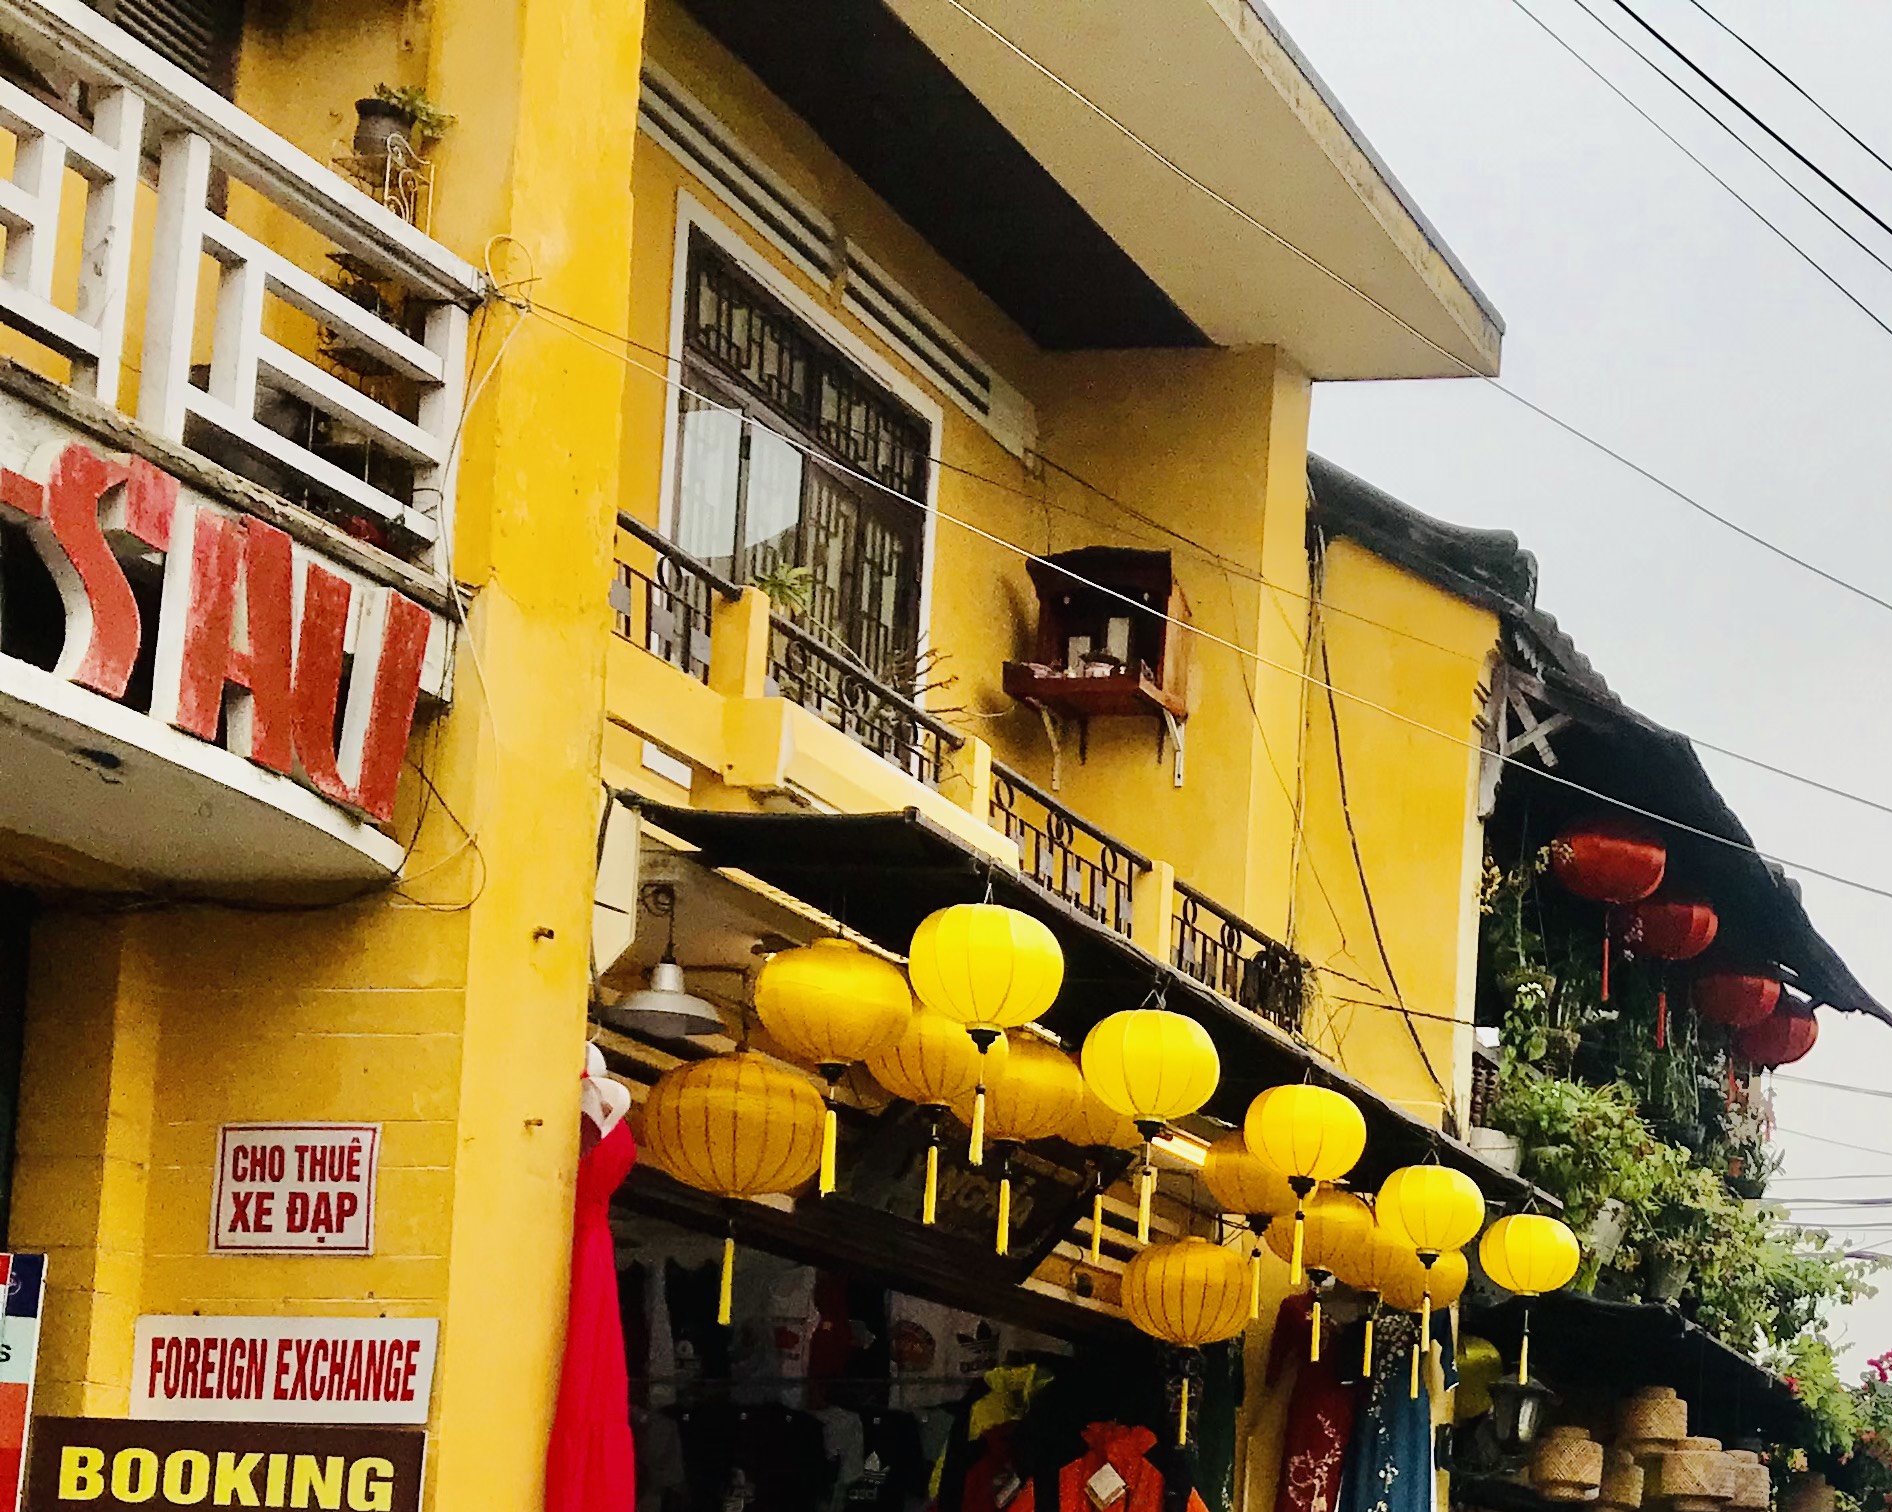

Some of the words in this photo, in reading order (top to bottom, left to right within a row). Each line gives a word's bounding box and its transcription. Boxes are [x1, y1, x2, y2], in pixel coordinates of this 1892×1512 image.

[232, 1144, 285, 1183] CHO
[294, 1137, 362, 1183] THUÊ
[229, 1192, 273, 1233] XE
[286, 1191, 358, 1244] ĐẠP
[148, 1337, 268, 1400] FOREIGN
[273, 1339, 421, 1402] EXCHANGE
[58, 1446, 394, 1512] BOOKING
